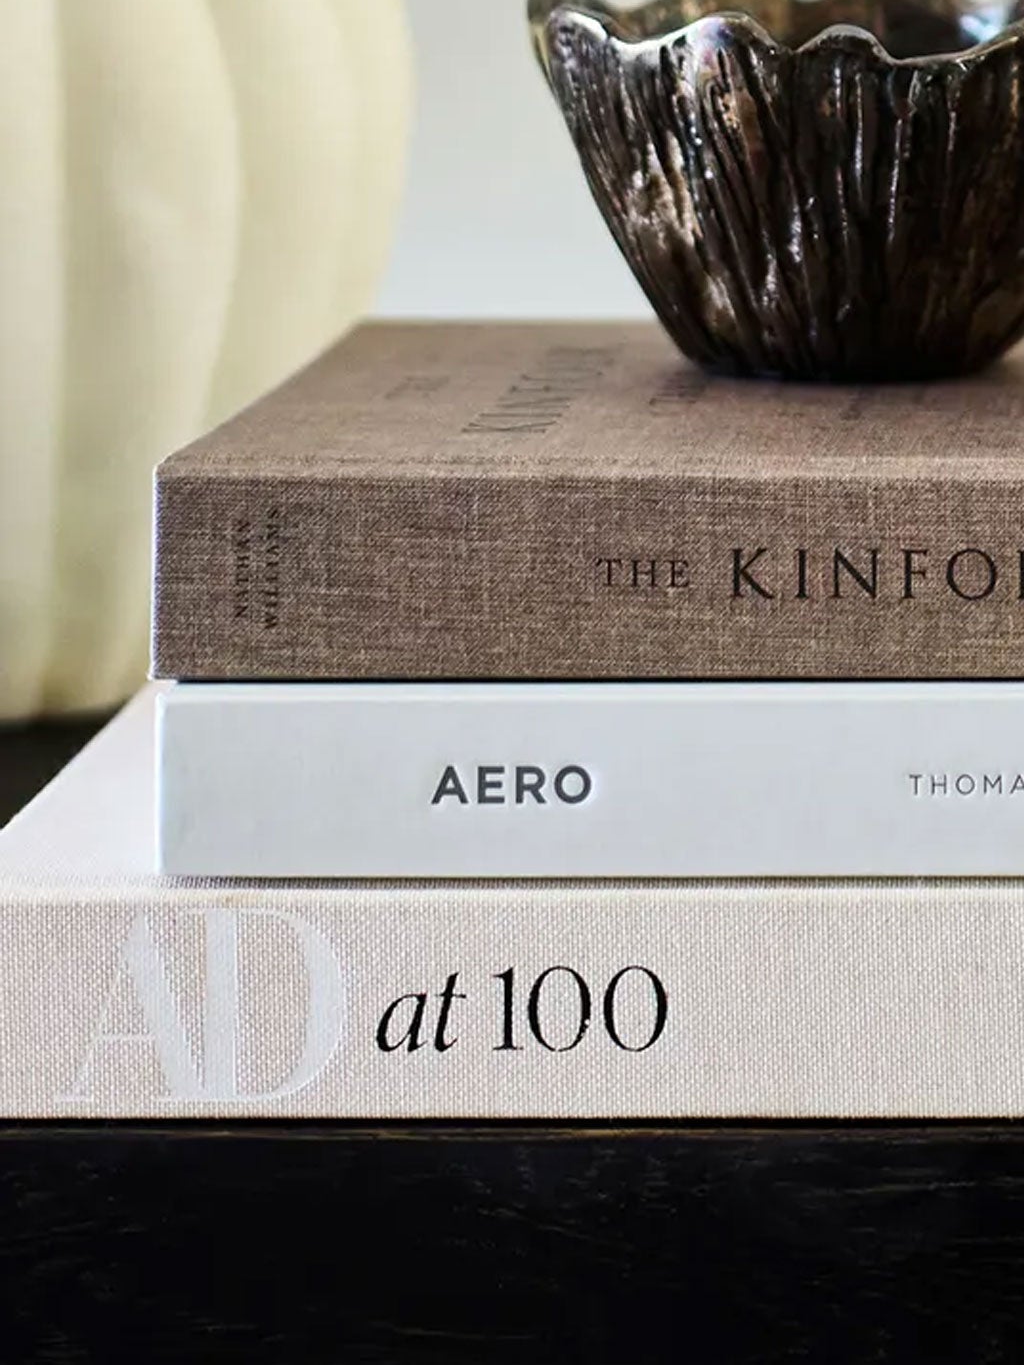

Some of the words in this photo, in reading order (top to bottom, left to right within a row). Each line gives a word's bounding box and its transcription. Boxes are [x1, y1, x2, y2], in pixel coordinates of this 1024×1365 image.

[234, 520, 250, 619] NATHAN
[264, 507, 279, 630] WILLIAMS
[594, 557, 691, 590] THE
[431, 765, 592, 805] AERO
[56, 906, 346, 1103] AD
[375, 972, 467, 1054] at
[493, 965, 669, 1052] 100
